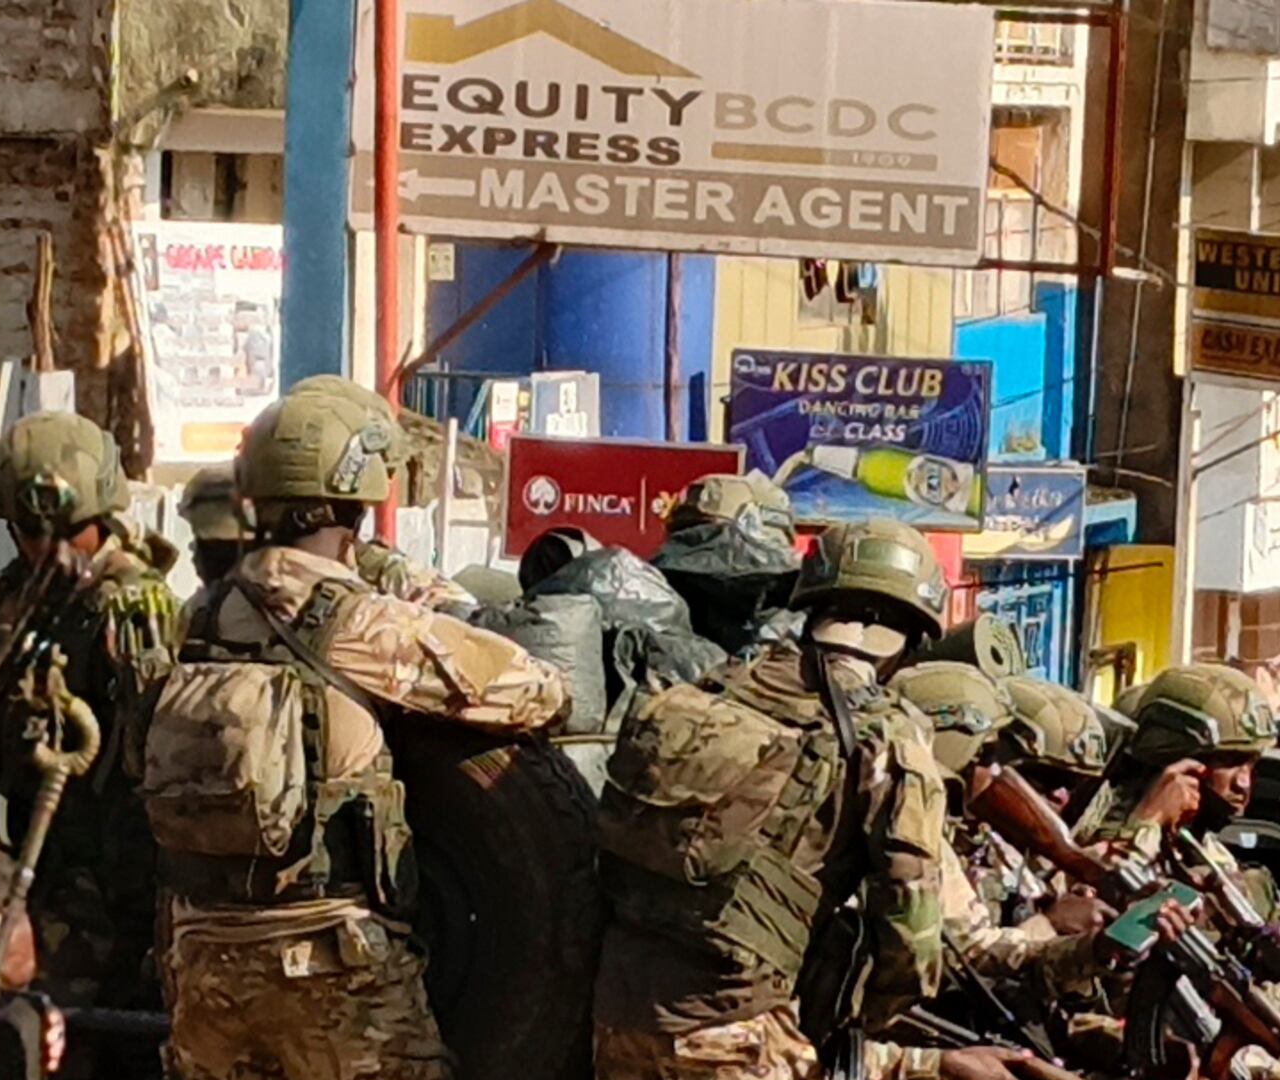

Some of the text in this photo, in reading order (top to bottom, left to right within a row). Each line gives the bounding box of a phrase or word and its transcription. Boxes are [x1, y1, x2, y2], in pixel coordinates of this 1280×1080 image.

[401, 73, 703, 126] EQUITY
[714, 91, 938, 142] BCDC
[399, 121, 681, 167] EXPRESS
[478, 167, 969, 235] MASTER AGENT
[772, 361, 848, 393] KISS
[855, 364, 944, 398] CLUB
[798, 399, 922, 420] DANCING BAR
[843, 421, 908, 443] CLASS
[563, 492, 631, 516] FINCA
